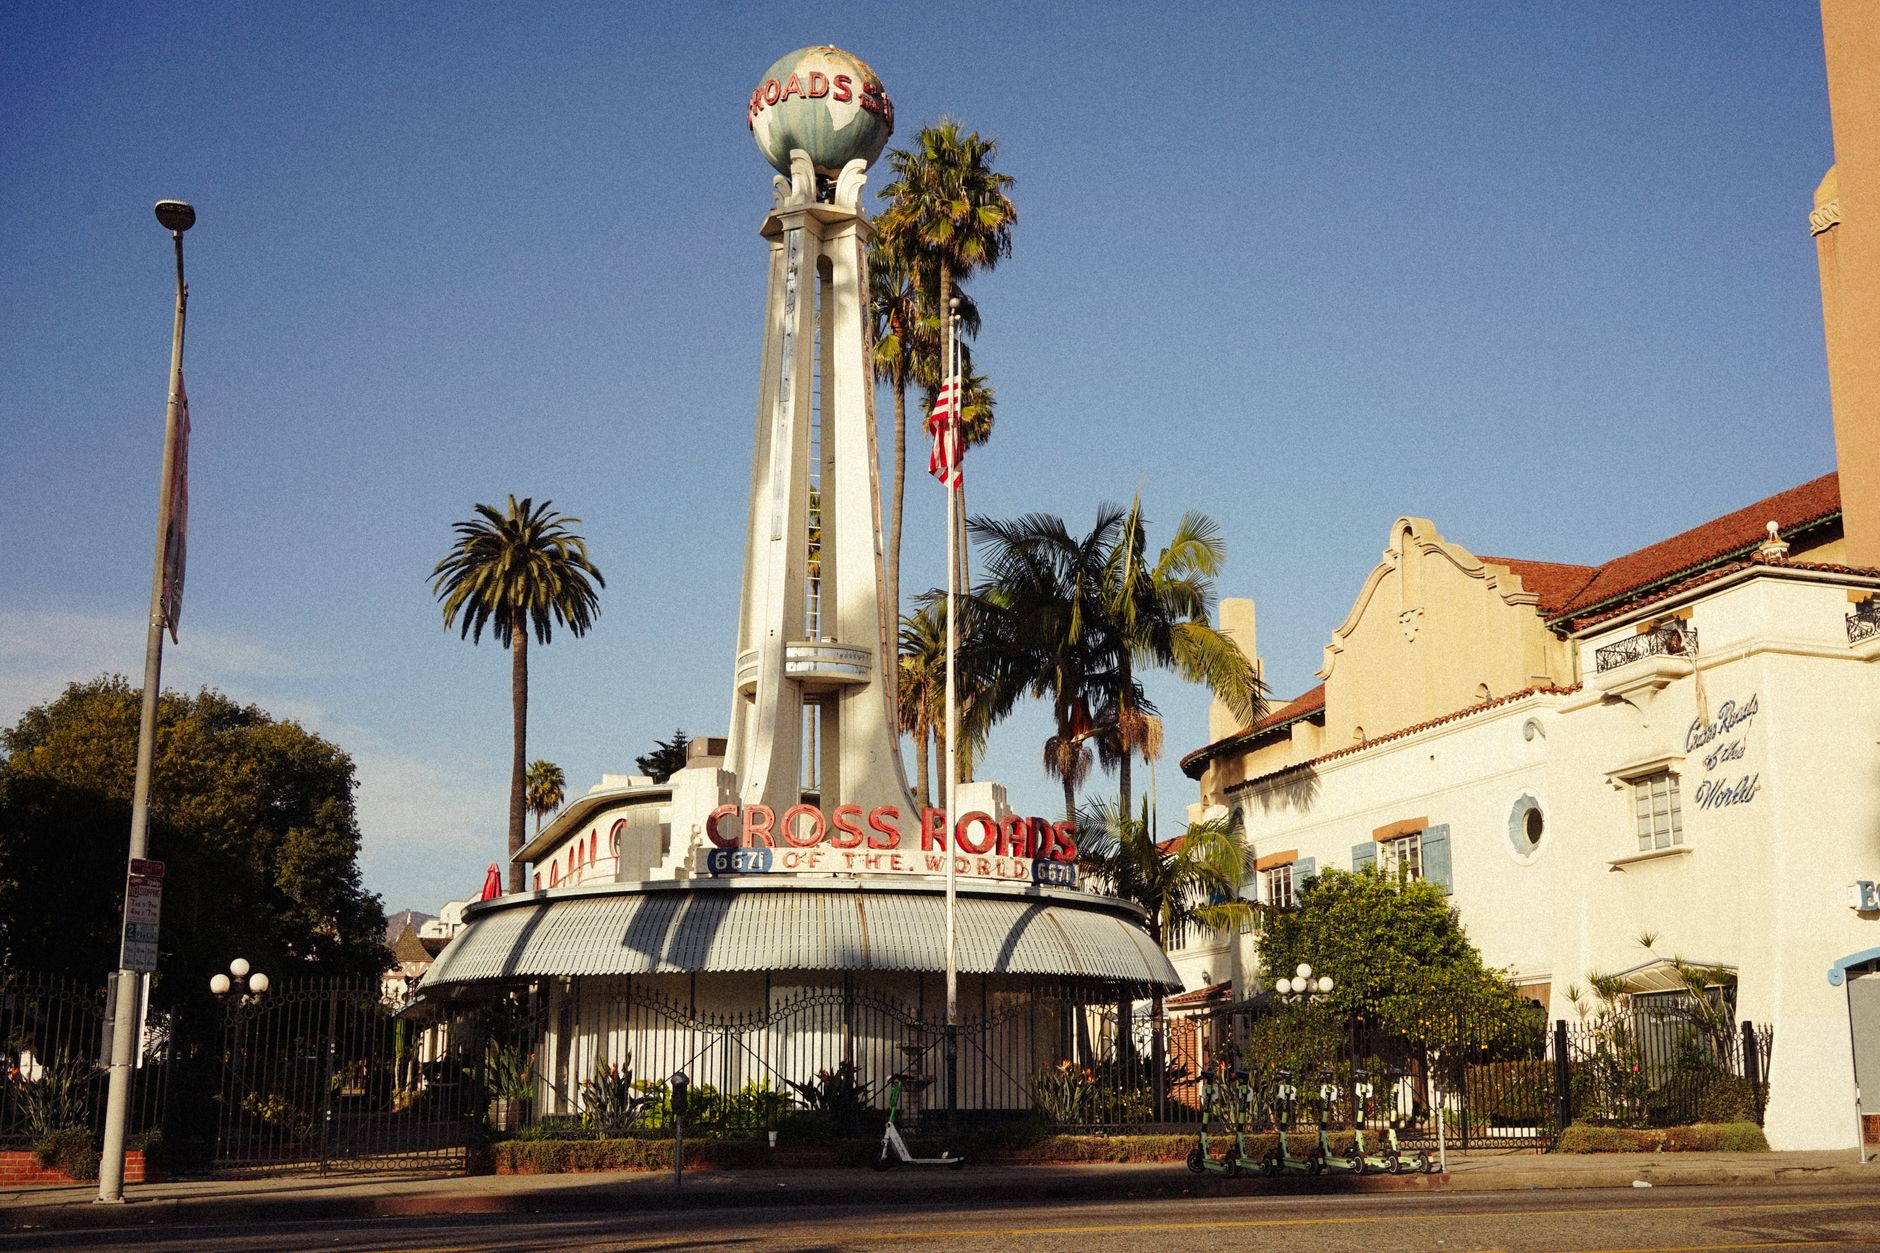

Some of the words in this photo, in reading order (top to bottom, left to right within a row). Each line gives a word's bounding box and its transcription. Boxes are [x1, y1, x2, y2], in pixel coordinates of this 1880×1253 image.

[752, 71, 852, 116] ROADS
[1695, 772, 1760, 812] World
[706, 803, 901, 849] CROSS
[921, 806, 1078, 864] ROADS
[714, 851, 764, 870] 6671
[782, 852, 823, 869] OF
[842, 852, 903, 871] THE
[924, 854, 1028, 879] WORLD
[1037, 862, 1072, 884] 6671
